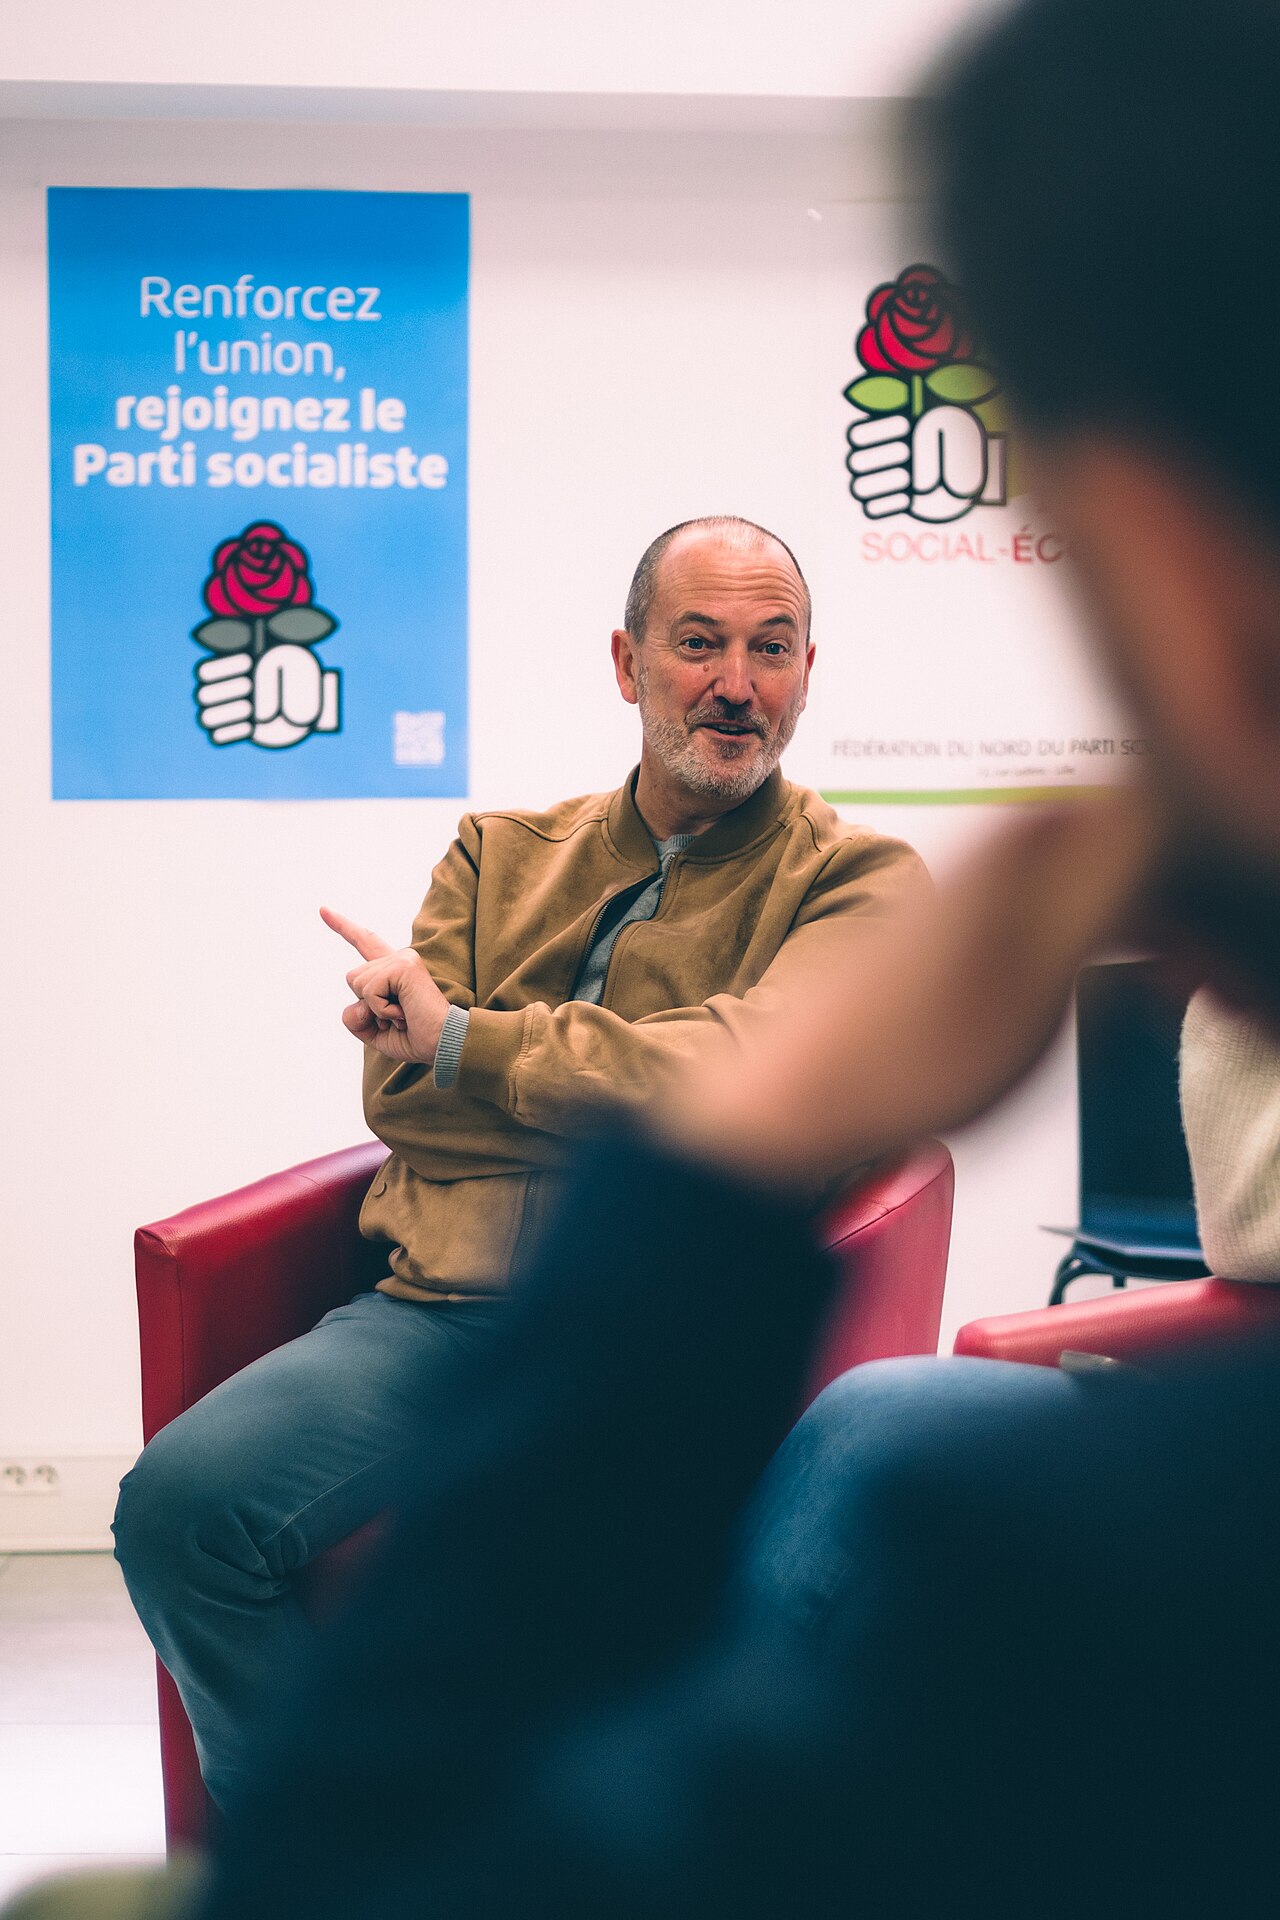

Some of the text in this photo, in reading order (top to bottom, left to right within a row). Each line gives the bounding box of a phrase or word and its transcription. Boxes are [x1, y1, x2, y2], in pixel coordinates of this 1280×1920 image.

[140, 274, 381, 320] Renforcez
[116, 386, 406, 441] rejoignez le
[73, 442, 448, 489] Parti socialiste
[862, 524, 1067, 564] SOCIAL-ÉC
[947, 739, 972, 758] DU
[980, 739, 1032, 758] NORD
[1038, 739, 1064, 757] DU
[1070, 738, 1115, 757] PARTI
